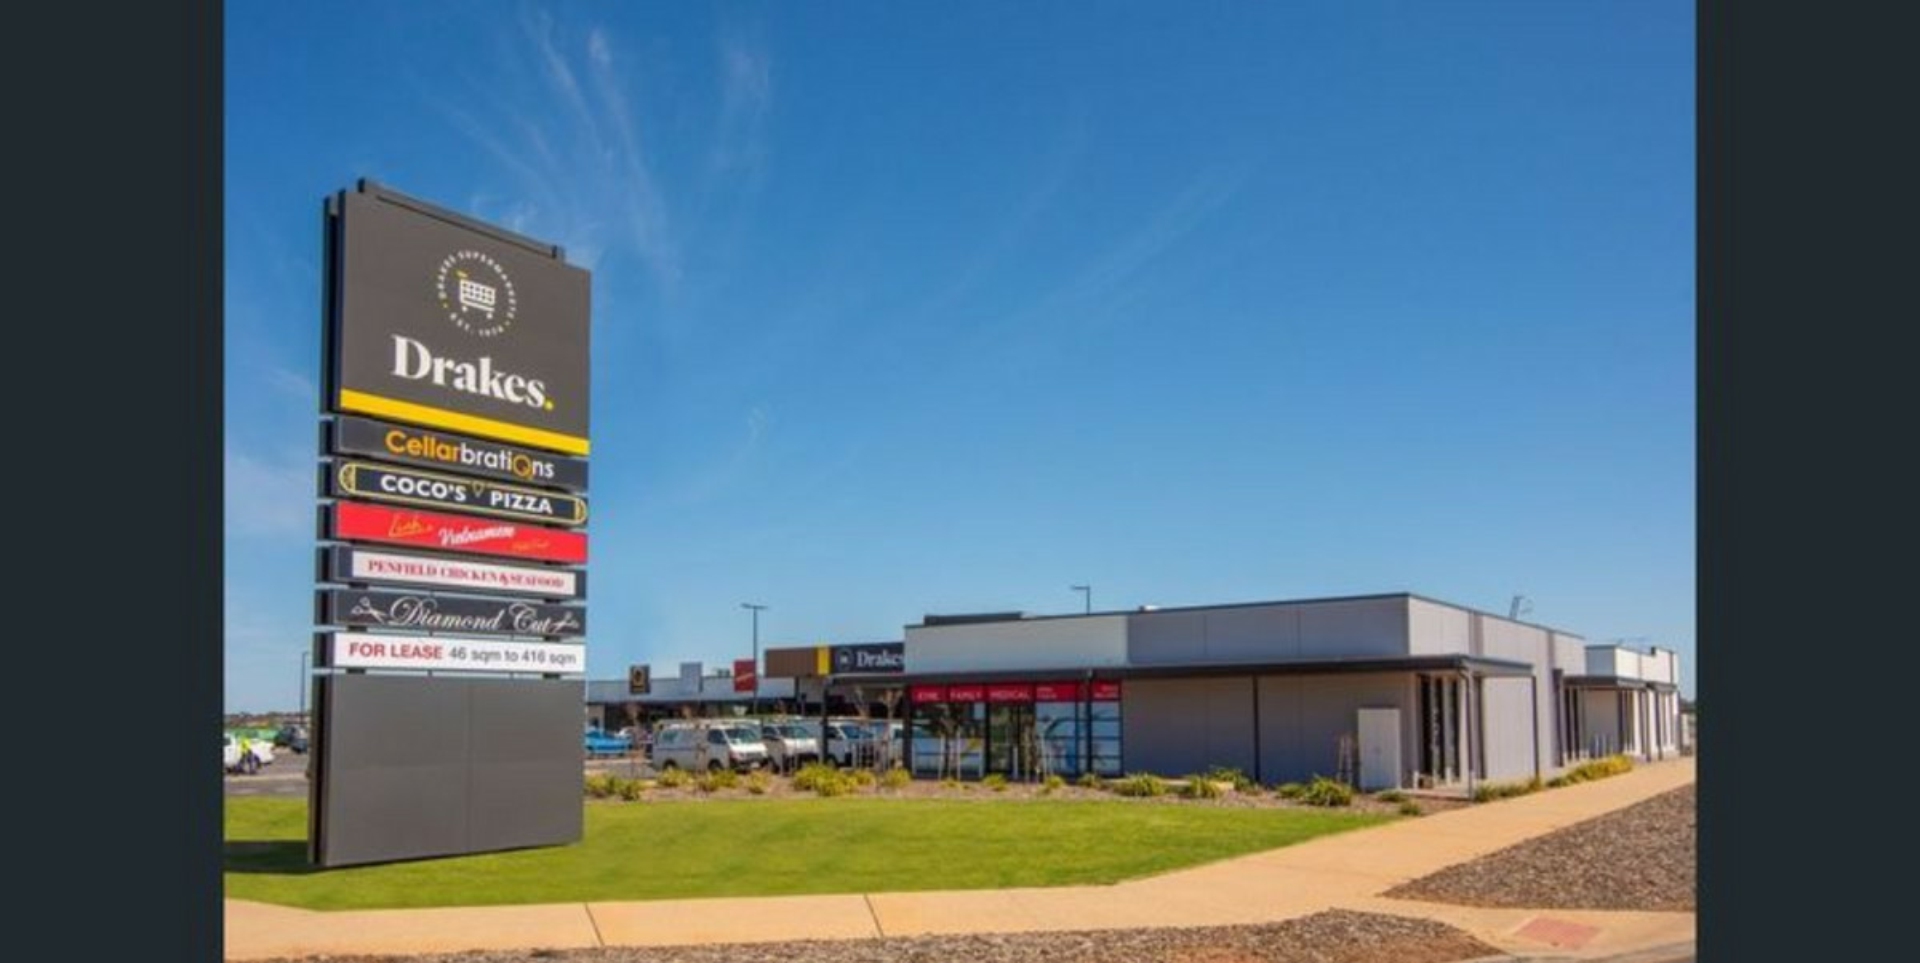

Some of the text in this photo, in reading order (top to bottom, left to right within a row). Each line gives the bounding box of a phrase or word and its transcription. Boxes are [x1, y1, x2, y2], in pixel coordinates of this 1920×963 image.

[380, 474, 553, 515] COCO'S PIZZA
[367, 558, 437, 577] PENFIELD
[388, 596, 551, 633] Diamond Cut
[349, 642, 577, 666] FOR LEASE 46 sqm to 416 sqm
